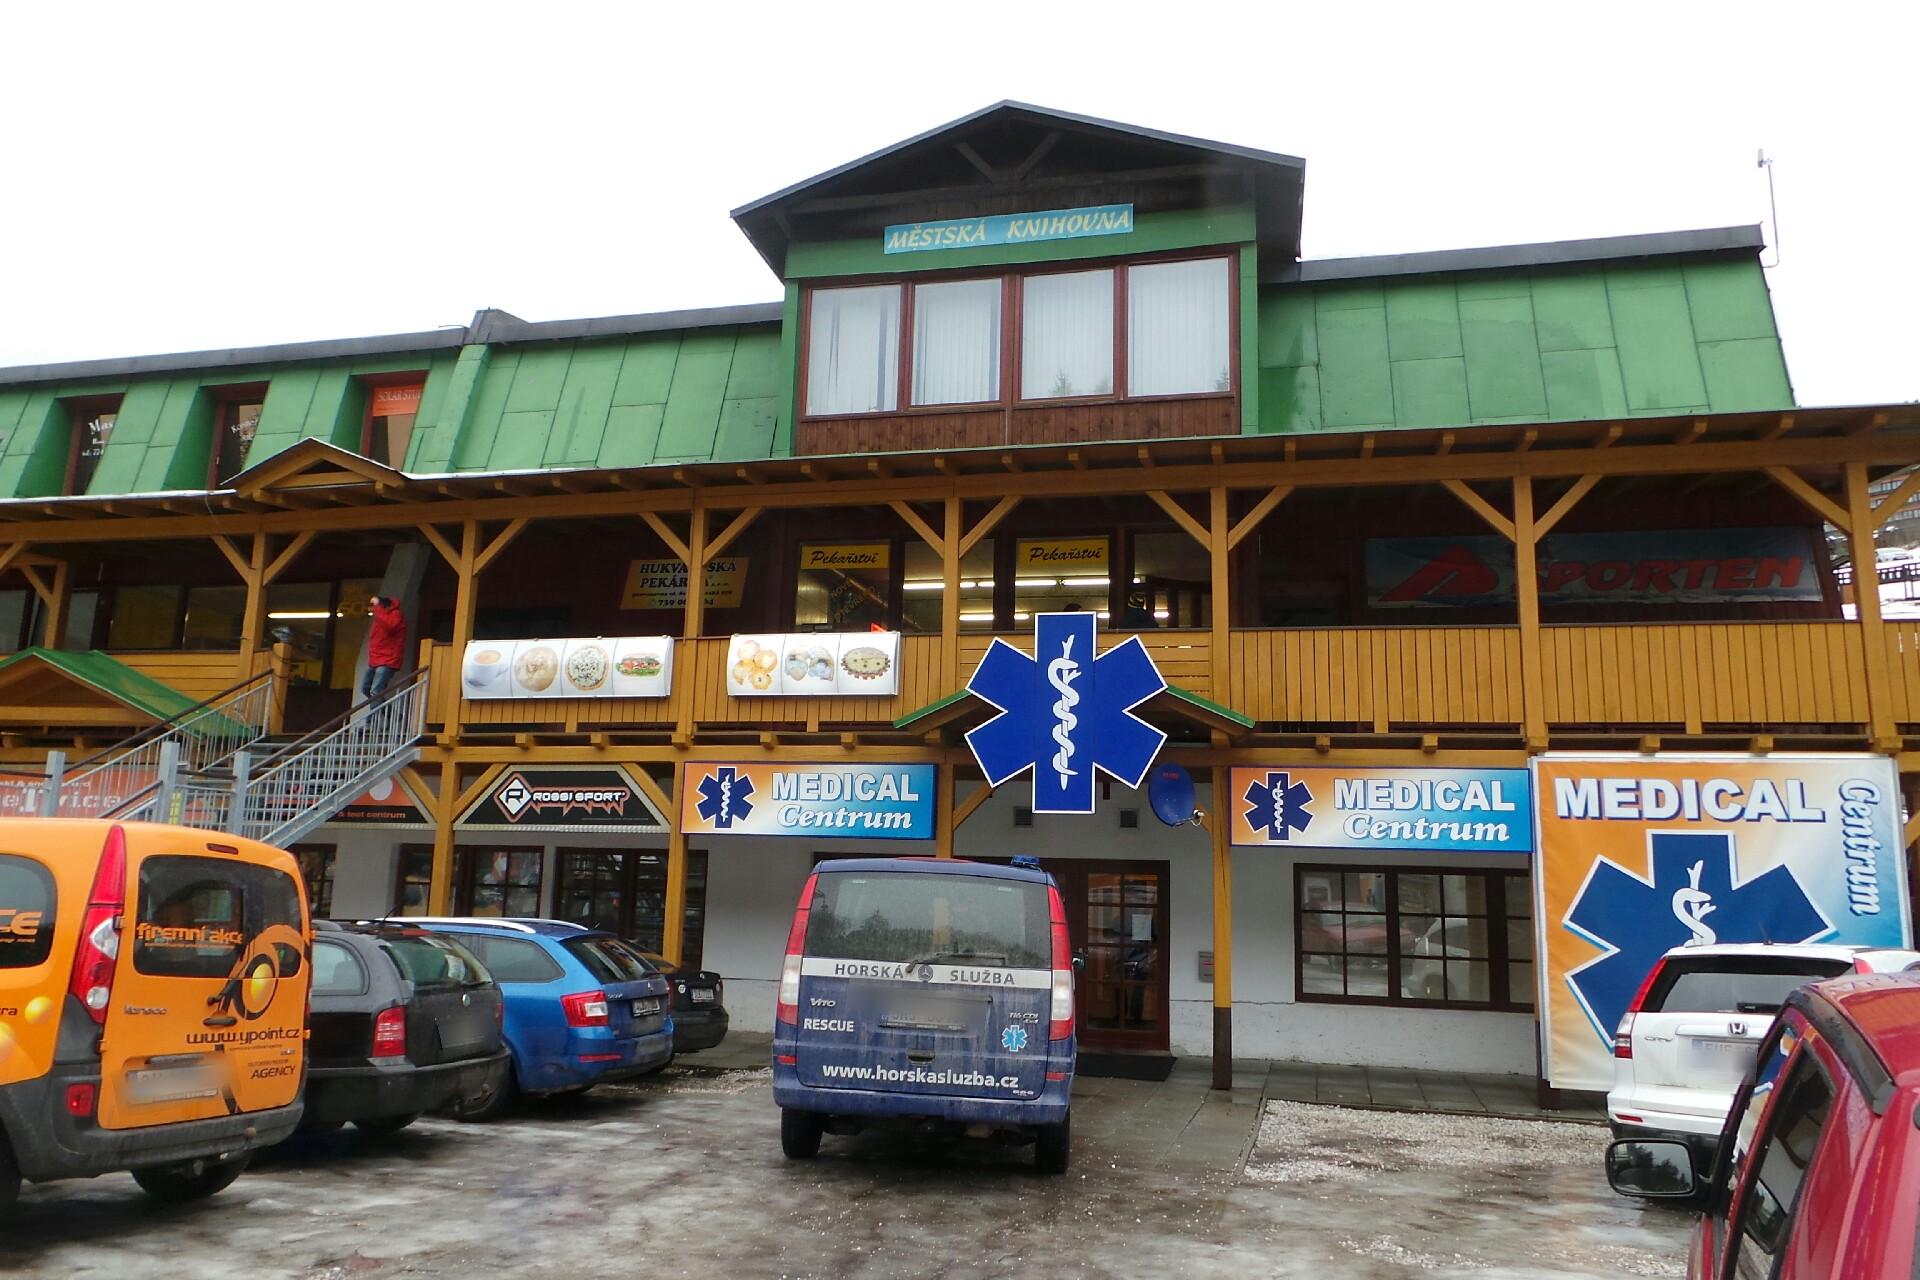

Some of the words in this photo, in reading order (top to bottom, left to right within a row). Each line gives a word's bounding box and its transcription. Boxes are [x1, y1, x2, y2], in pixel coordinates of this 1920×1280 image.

[888, 220, 986, 249] MĚSTSKÁ
[1007, 210, 1130, 240] KNIHOVNA
[810, 550, 879, 566] Pekařství
[1028, 545, 1103, 564] Pekařství
[640, 561, 737, 574] HUKVASKÁ
[532, 791, 573, 803] ROSSI
[574, 791, 624, 803] SPORT
[771, 772, 920, 802] MEDICAL
[1334, 777, 1516, 812] MEDICAL
[1554, 777, 1826, 823] MEDICAL
[776, 804, 914, 830] Centrum
[1343, 813, 1510, 842] Centrum
[1838, 778, 1882, 918] Centrum
[835, 962, 904, 979] HORSKÁ
[950, 968, 1016, 986] SLUŽBA
[186, 1026, 300, 1045] www.ypoint.cz
[803, 1018, 855, 1032] RESCUE
[250, 1065, 296, 1080] AGENCY
[822, 1064, 1020, 1088] www.horskasluzba.cz
